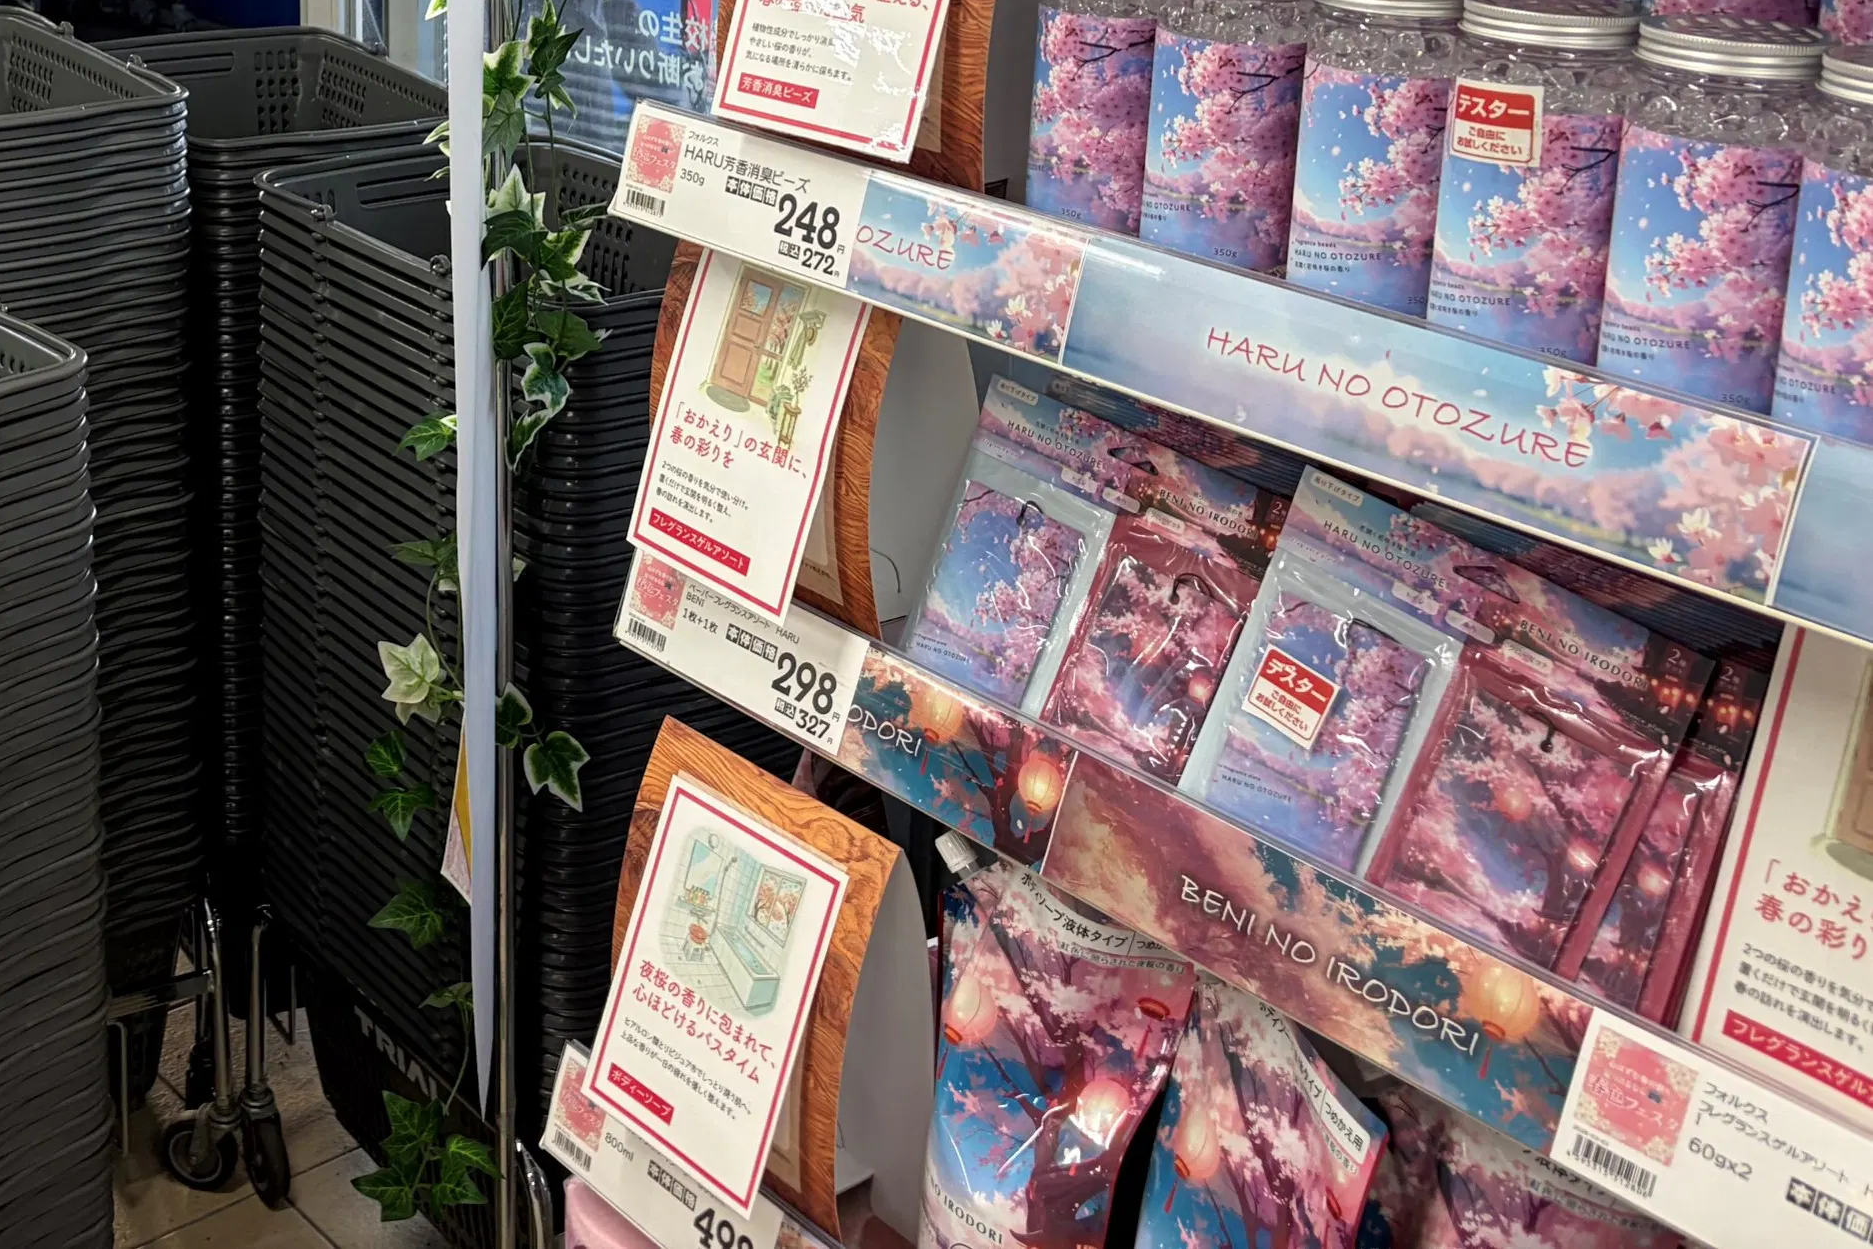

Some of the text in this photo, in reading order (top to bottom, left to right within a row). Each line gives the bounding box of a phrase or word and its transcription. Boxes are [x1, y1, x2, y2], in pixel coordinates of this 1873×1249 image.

[741, 75, 814, 103] 芳香消臭ビーズ
[1457, 92, 1531, 119] テスター
[688, 130, 719, 147] フォルクス
[1456, 135, 1523, 157] お試しください
[1467, 125, 1506, 142] ご自由に
[679, 168, 706, 187] 350g
[683, 144, 810, 194] HARU芳香消臭ビーズ
[1060, 206, 1083, 221] 350g
[1329, 250, 1384, 263] OTOZURE
[1458, 293, 1512, 307] OTOZURE
[1632, 338, 1691, 351] OTOZURE
[1205, 326, 1593, 469] HARU NO OTOZURE
[1787, 379, 1837, 395] OTOZURE
[669, 425, 735, 469] 春の彩りを
[676, 401, 808, 479] 「おかえり」の玄関に、
[1006, 419, 1035, 438] HARU
[1037, 433, 1052, 447] NO
[1159, 489, 1259, 540] BENI NO IRODORI
[652, 511, 745, 570] フレグランスゲルアソート
[1322, 519, 1447, 589] HARU NO OTOZURE
[685, 591, 705, 608] BENI
[775, 625, 800, 645] HARU
[1520, 618, 1553, 644] BENI
[1558, 638, 1579, 656] NO
[1583, 650, 1649, 692] IRODORI
[1254, 692, 1309, 733] お試しください
[1270, 689, 1302, 715] ご自由に
[1221, 773, 1241, 786] HARU
[1256, 785, 1293, 804] OTOZURE
[1178, 874, 1480, 1058] BENI NO IRODORI
[639, 958, 776, 1070] 夜桜の香りに包まれて、
[632, 982, 760, 1084] 心ほどけるバスタイム
[611, 1068, 672, 1117] ボディーソープ
[1701, 1080, 1769, 1125] フォルクス
[1324, 1100, 1365, 1153] つめかえ用
[1698, 1099, 1850, 1184] フレグランスゲルアソート
[604, 1131, 635, 1163] 800ml
[943, 1187, 1004, 1246] IRODORI
